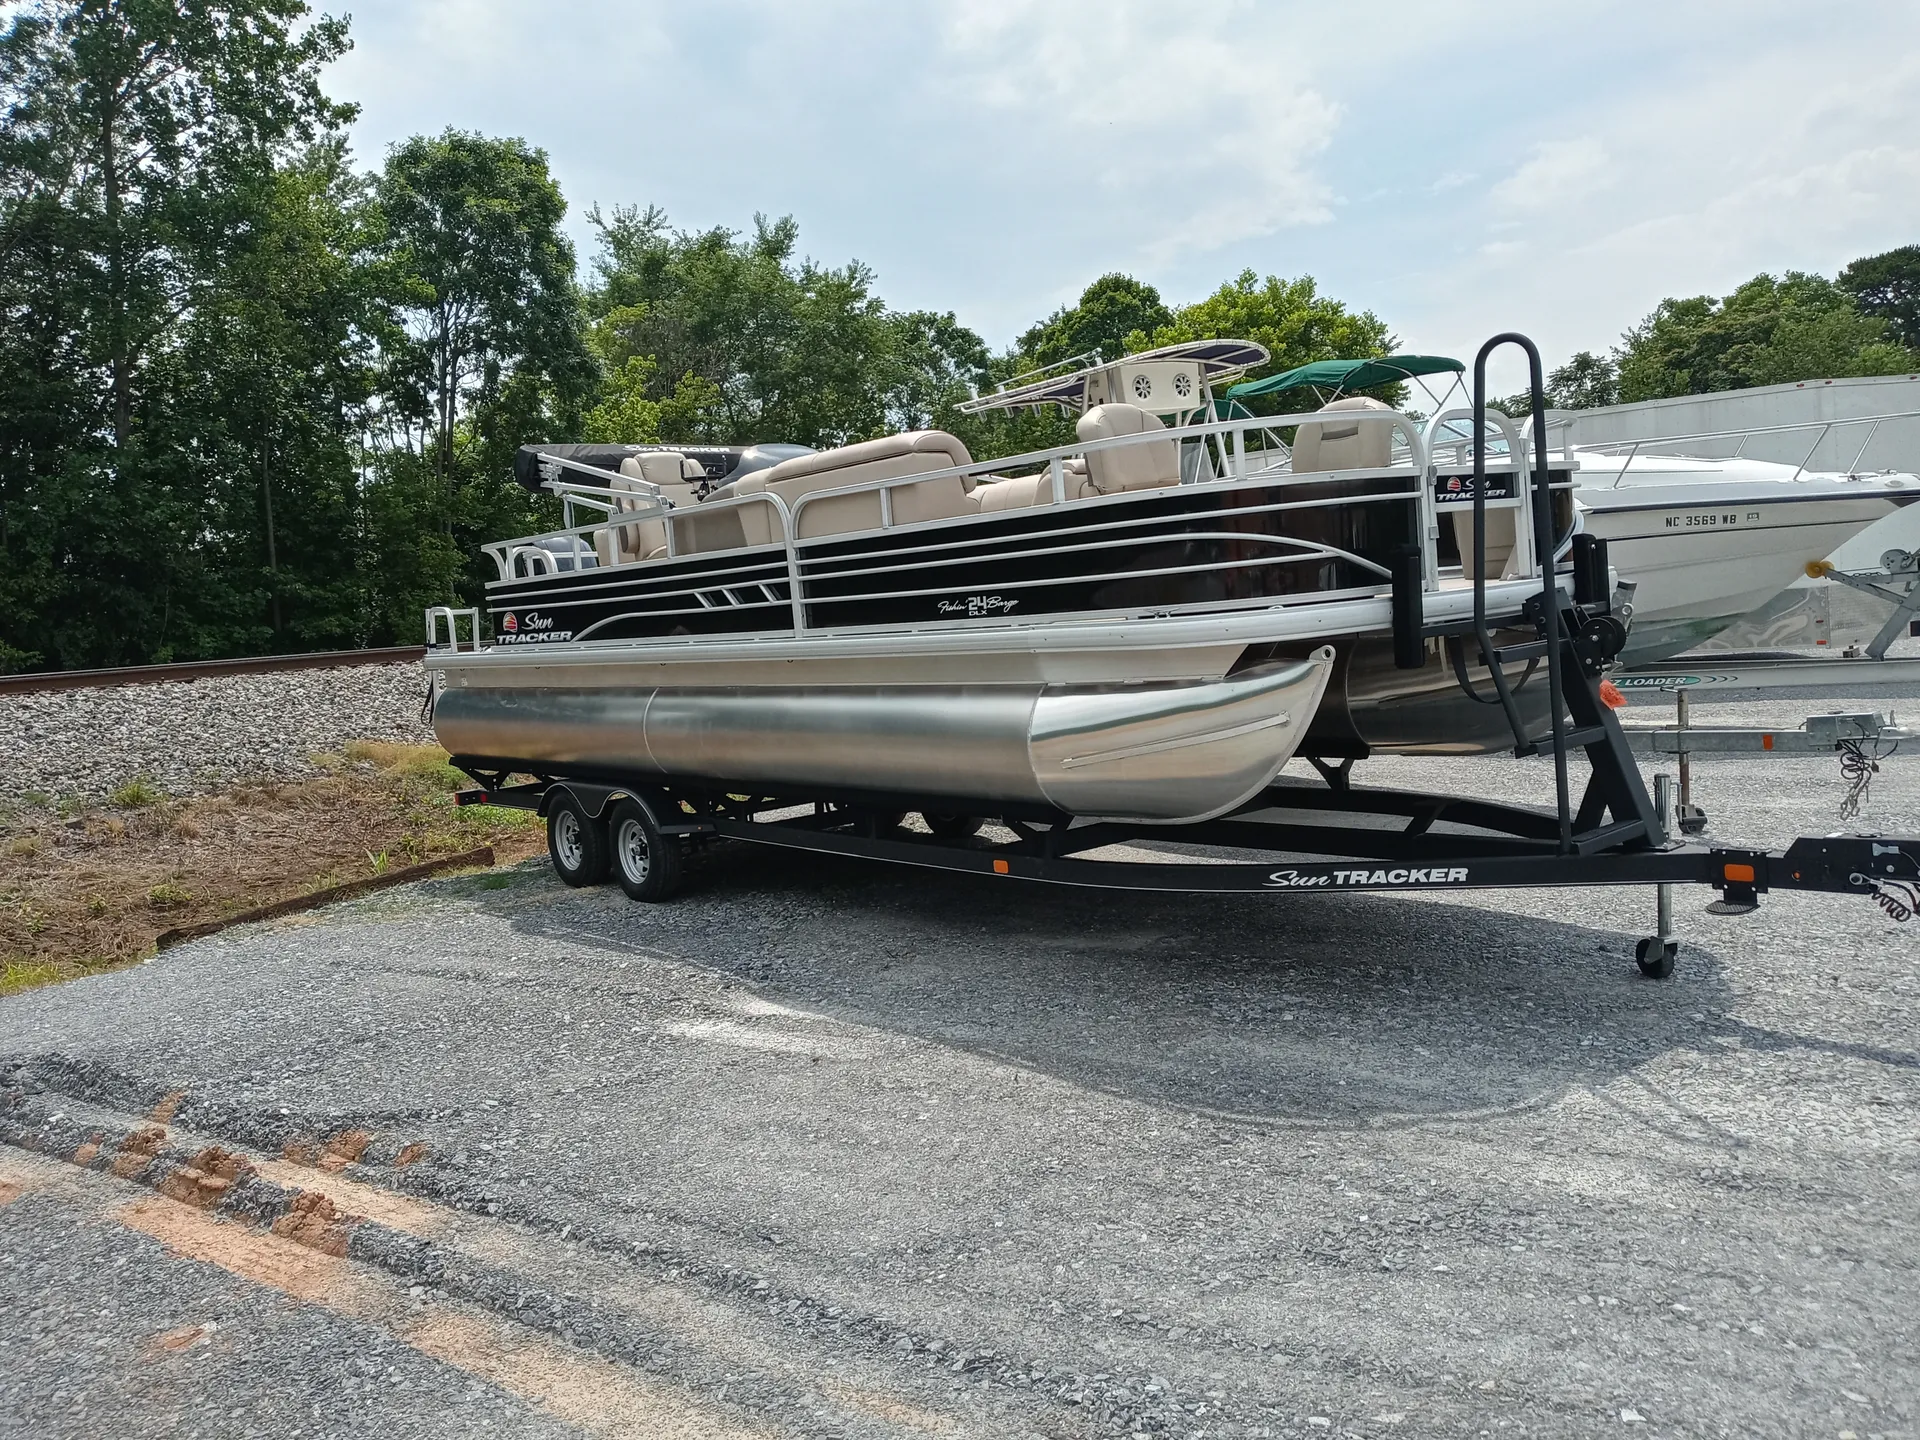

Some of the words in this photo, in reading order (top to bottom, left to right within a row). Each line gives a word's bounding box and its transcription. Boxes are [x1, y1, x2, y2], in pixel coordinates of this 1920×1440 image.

[1665, 516, 1680, 527] NC
[1685, 515, 1717, 526] 3569
[1722, 514, 1737, 524] WB
[967, 596, 987, 610] 24
[986, 596, 1019, 613] Barge
[521, 612, 553, 630] Sun
[496, 631, 572, 644] TRACKER
[1625, 677, 1687, 686] LOADER
[1262, 870, 1331, 887] Sun
[1332, 867, 1469, 885] TRACKER
